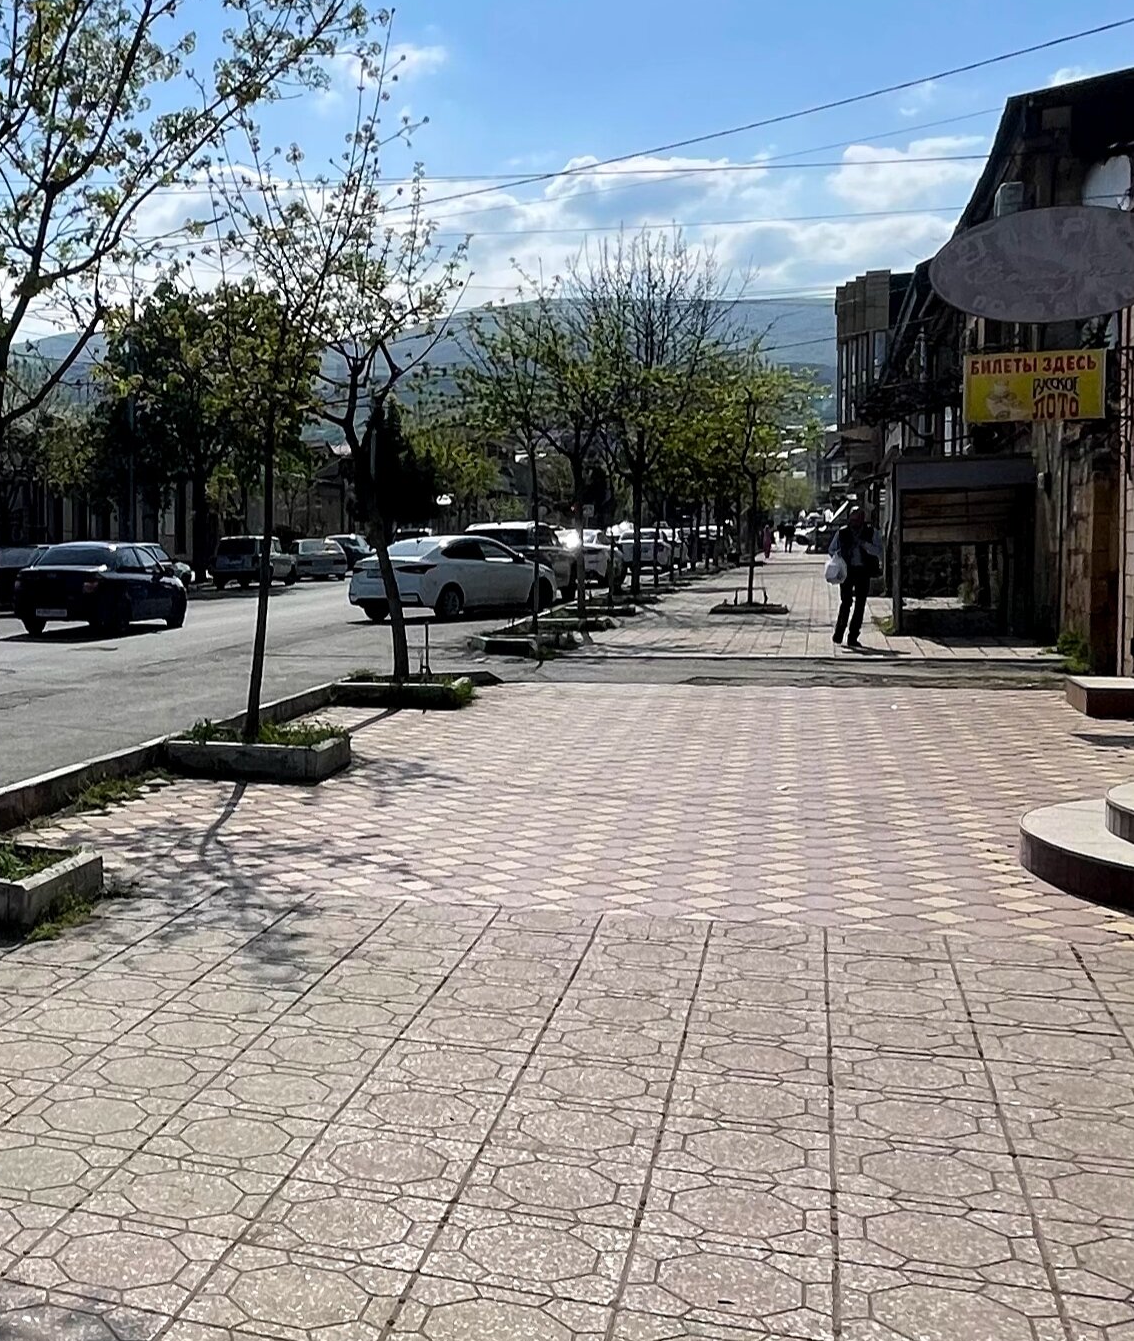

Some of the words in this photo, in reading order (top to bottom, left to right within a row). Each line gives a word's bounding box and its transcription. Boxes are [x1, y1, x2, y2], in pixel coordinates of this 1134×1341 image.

[970, 357, 1037, 375] БИЛЕТЫ
[1042, 354, 1097, 374] ЗДЕСЬ
[1032, 376, 1080, 399] РУССКОЕ
[1032, 393, 1080, 419] ЛОТО
